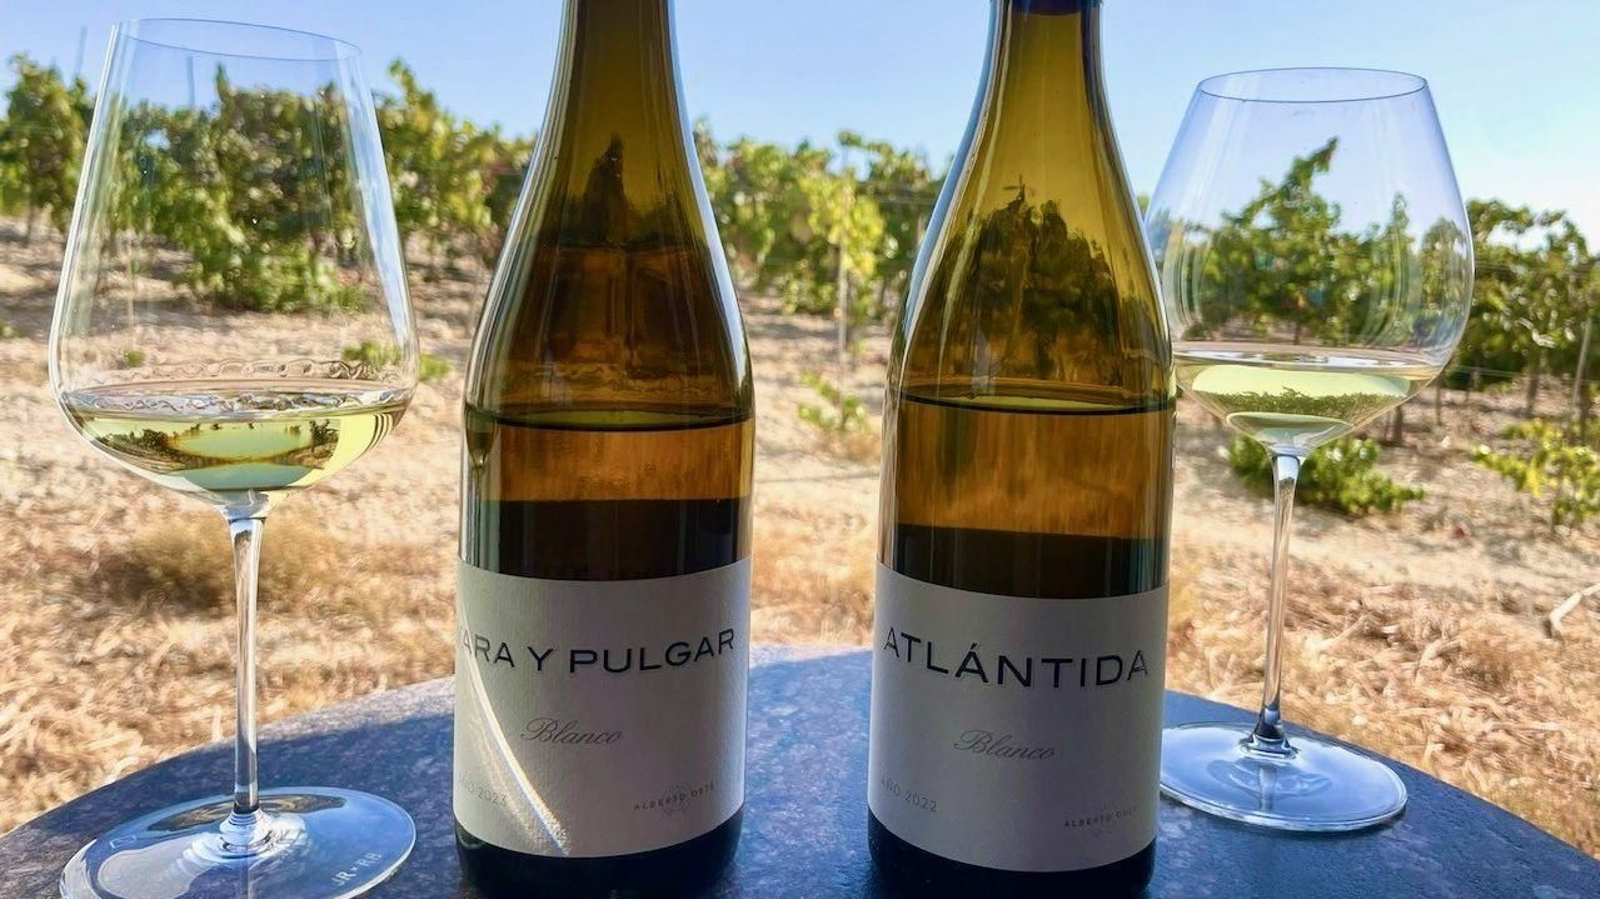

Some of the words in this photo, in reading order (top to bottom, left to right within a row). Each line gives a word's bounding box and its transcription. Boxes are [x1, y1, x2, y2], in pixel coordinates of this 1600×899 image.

[527, 646, 554, 671] Y
[569, 628, 735, 674] PULGAR
[883, 626, 1149, 689] ATLÁNTIDA
[520, 717, 622, 744] Blanco
[953, 730, 1055, 760] Blanco
[903, 790, 938, 812] 2022
